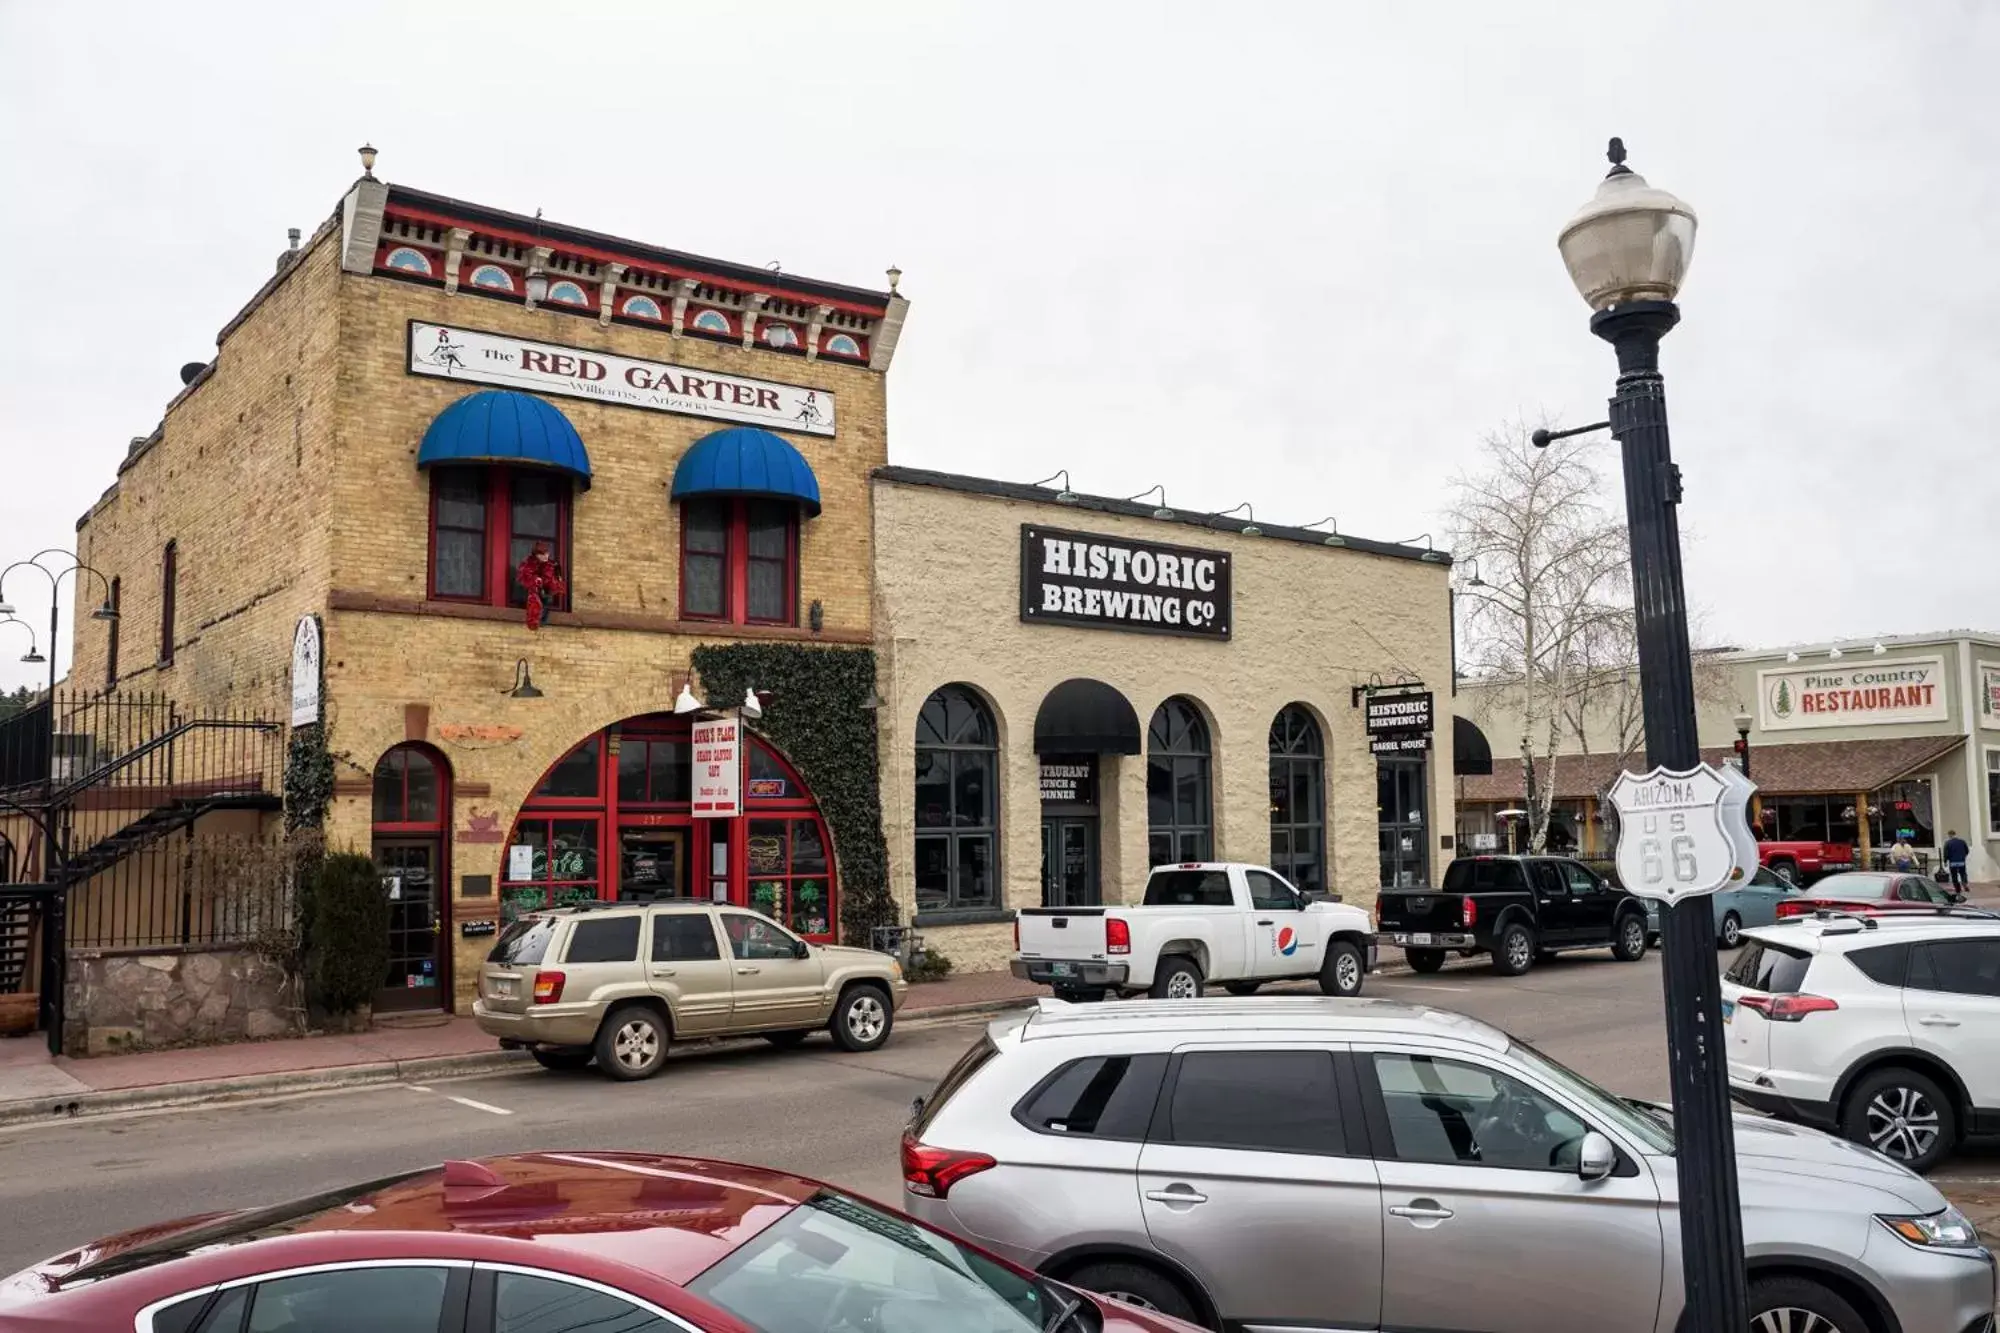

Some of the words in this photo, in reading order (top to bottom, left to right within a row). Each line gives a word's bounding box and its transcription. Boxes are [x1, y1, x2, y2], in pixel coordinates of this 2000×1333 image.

[480, 348, 514, 363] The
[520, 347, 607, 383] RED
[624, 366, 783, 412] GARTER
[646, 394, 709, 412] Arizona
[1042, 537, 1216, 592] HISTORIC
[1042, 583, 1181, 624] BREWING
[1803, 674, 1844, 689] Pine
[1851, 668, 1930, 685] Country
[1369, 701, 1428, 716] HISTORIC
[1802, 684, 1935, 713] RESTAURANT
[1369, 715, 1415, 727] BREWING
[1372, 741, 1399, 751] BARREL
[1401, 739, 1426, 749] HOUSE
[1633, 783, 1696, 806] ARIZONA
[1640, 835, 1698, 884] 66
